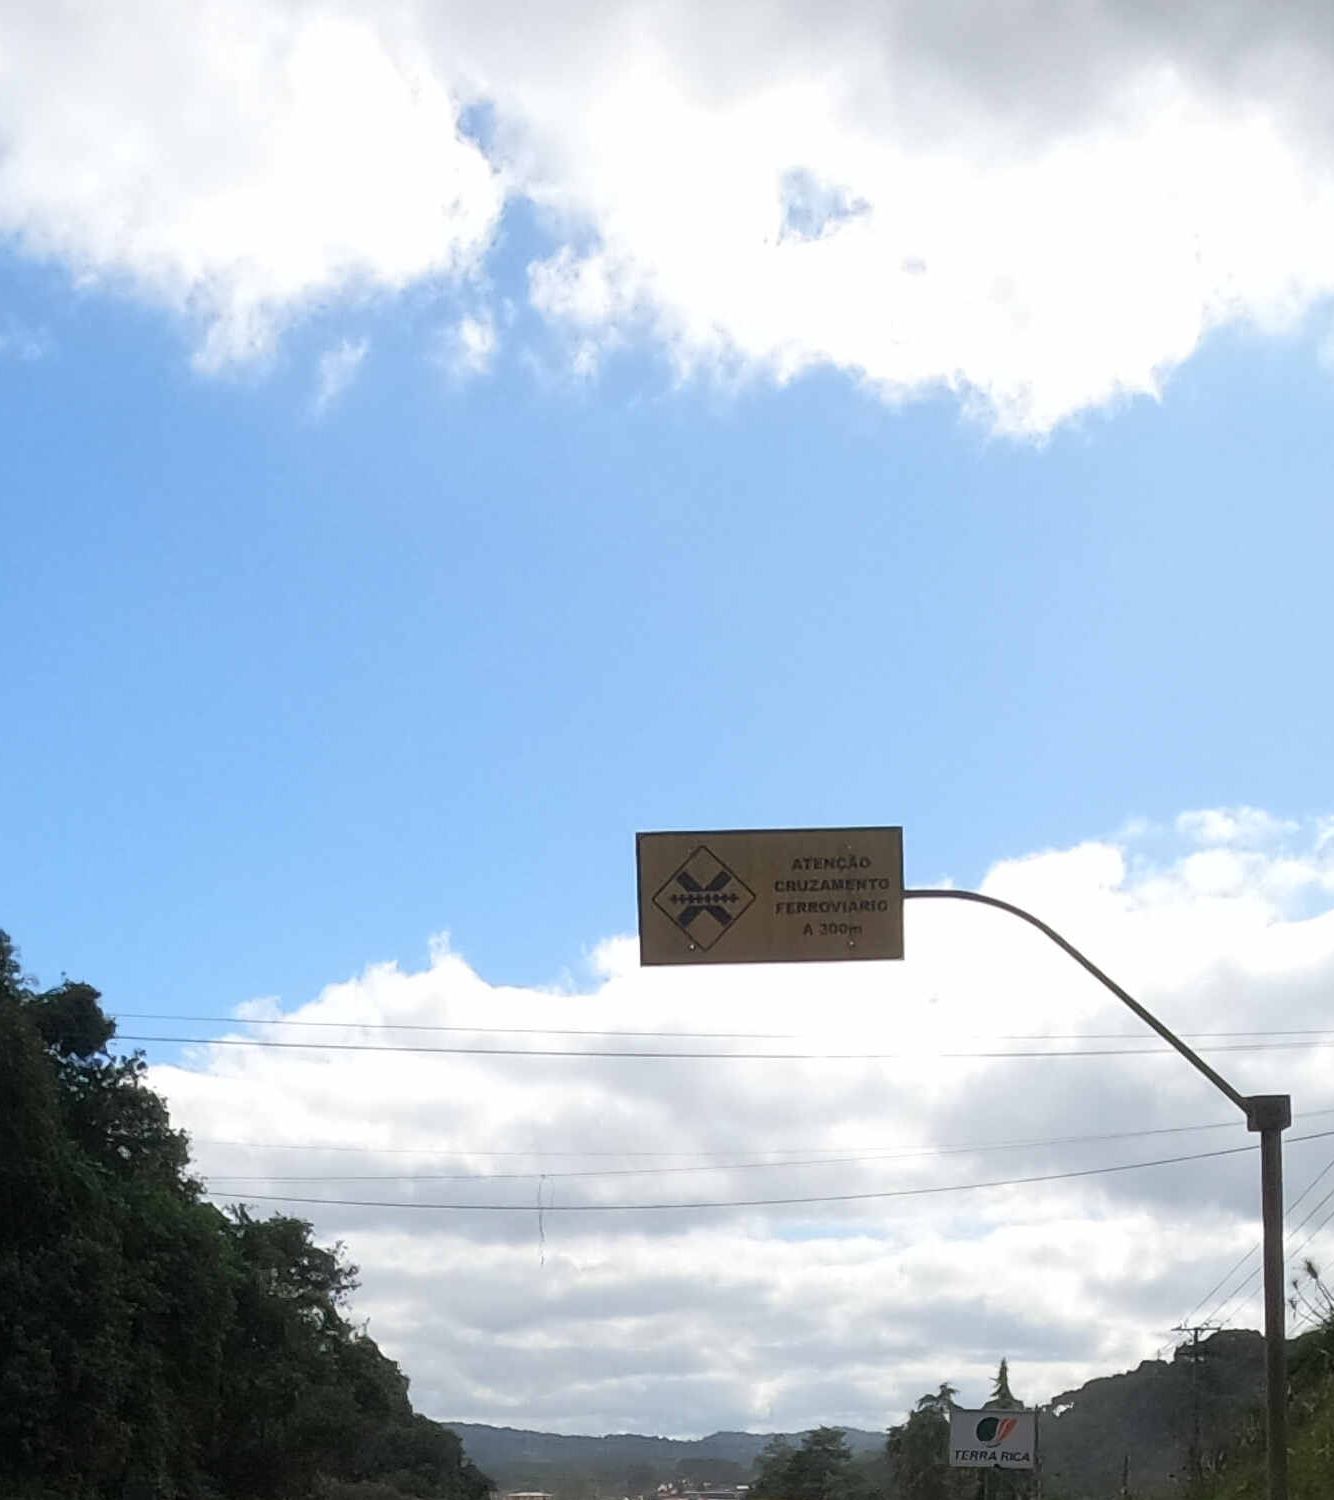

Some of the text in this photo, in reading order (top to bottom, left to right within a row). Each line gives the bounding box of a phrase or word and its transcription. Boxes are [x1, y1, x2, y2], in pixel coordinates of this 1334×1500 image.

[791, 855, 872, 871] ATENÇÃO
[774, 878, 891, 892] CRUZAMENTO
[803, 923, 813, 936] A
[955, 1450, 1030, 1462] TERRA RICA
